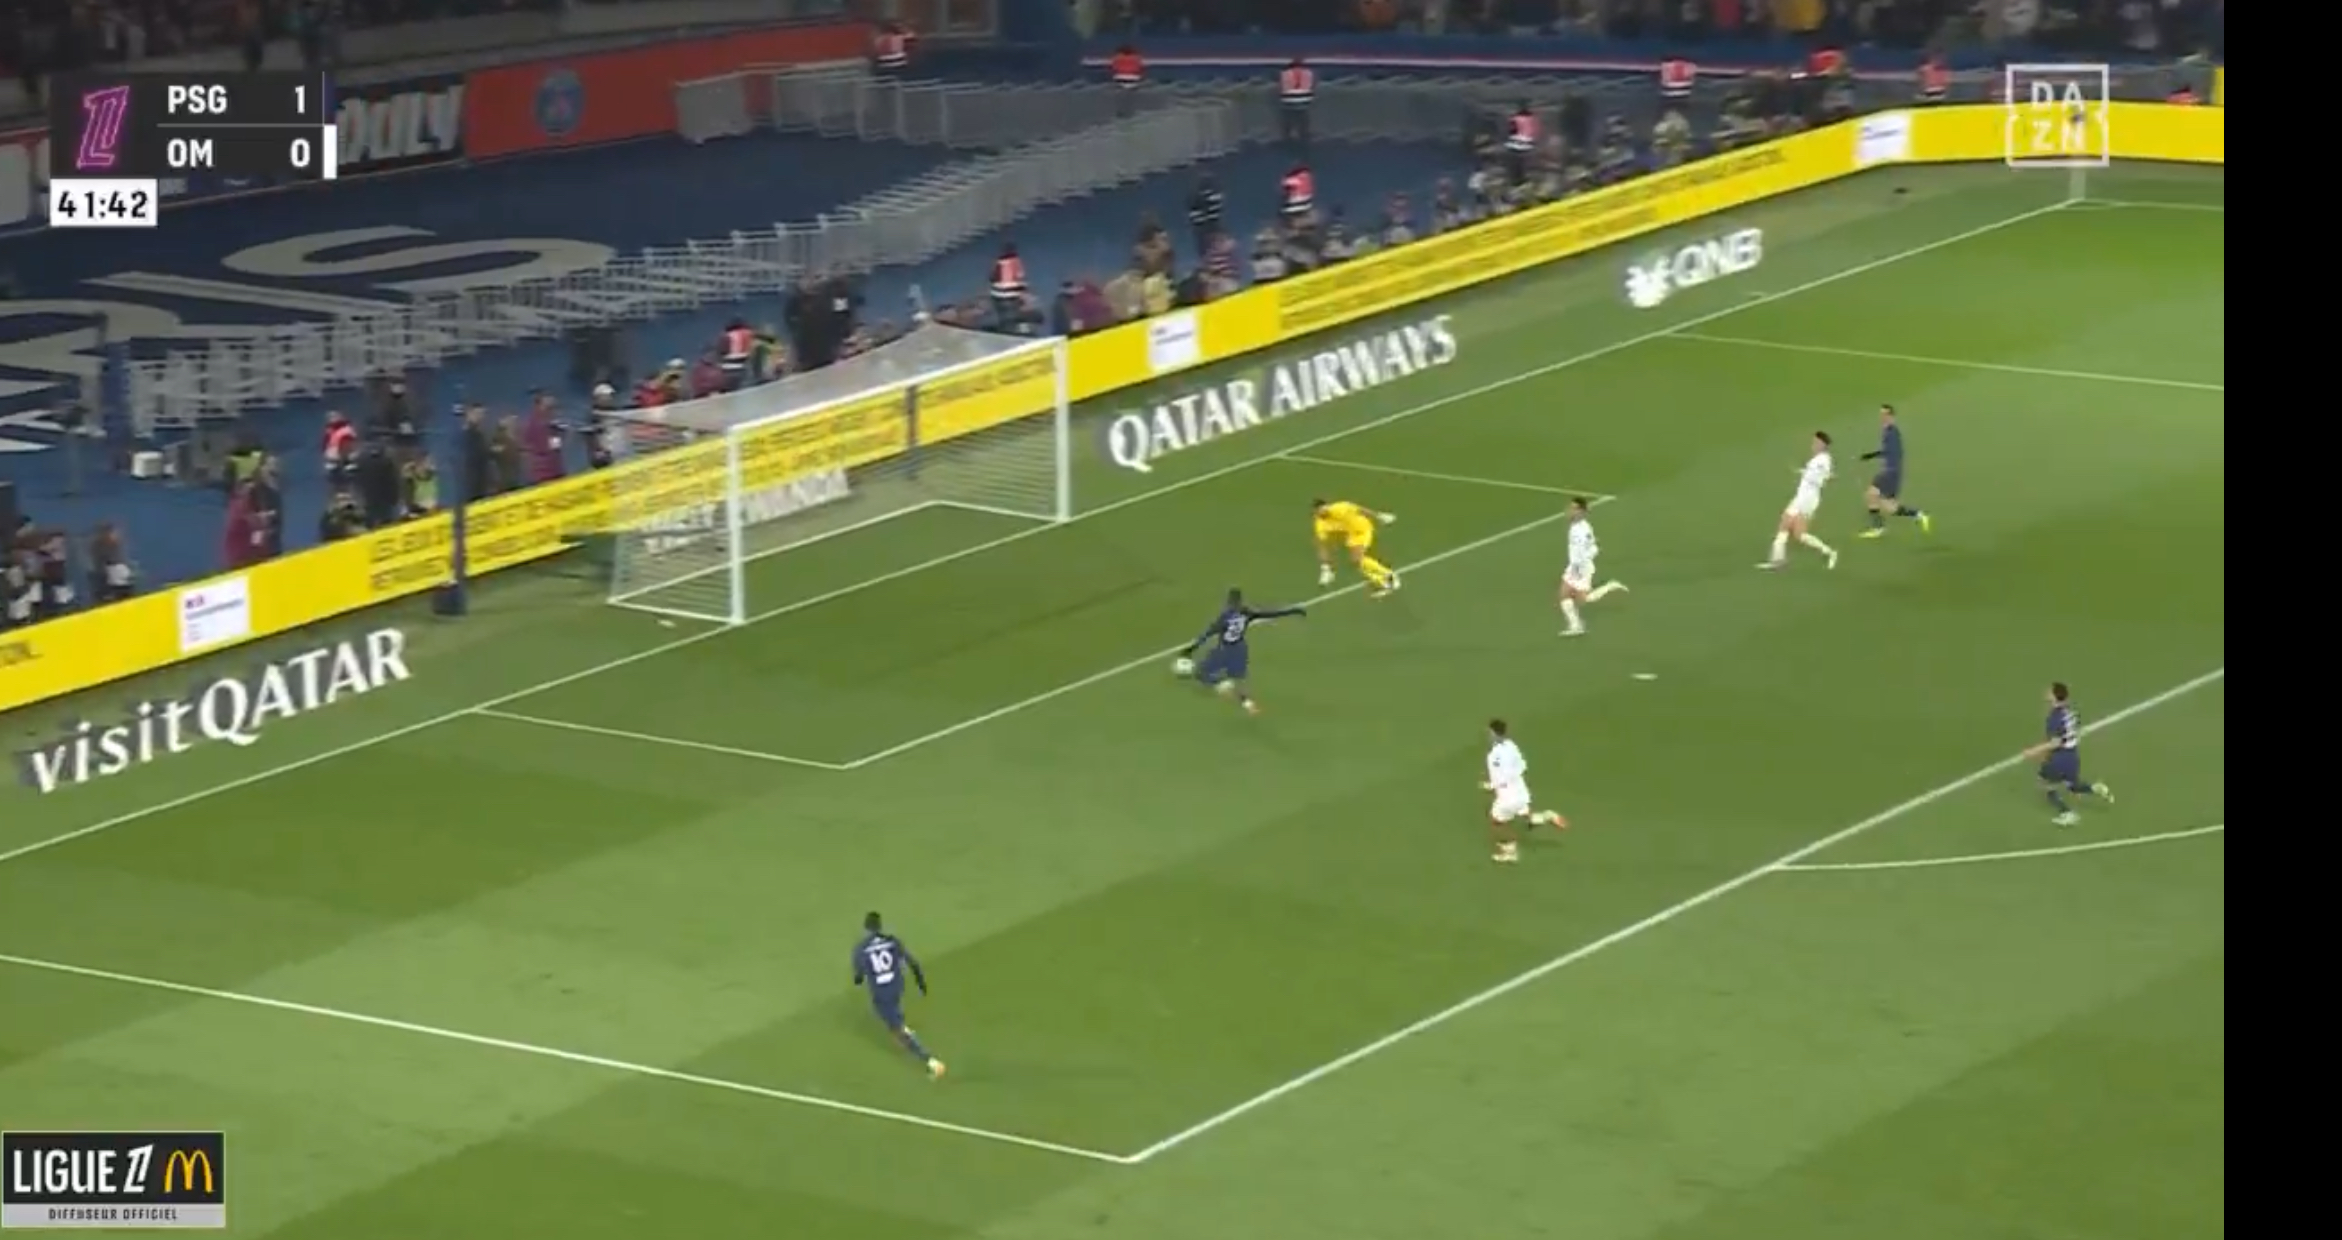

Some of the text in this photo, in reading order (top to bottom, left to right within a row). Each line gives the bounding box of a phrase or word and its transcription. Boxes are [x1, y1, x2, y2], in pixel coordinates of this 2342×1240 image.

[1673, 228, 1763, 288] QNB
[1108, 378, 1262, 473] QATAR
[1270, 314, 1458, 418] AIRWAYS
[870, 951, 894, 973] 10
